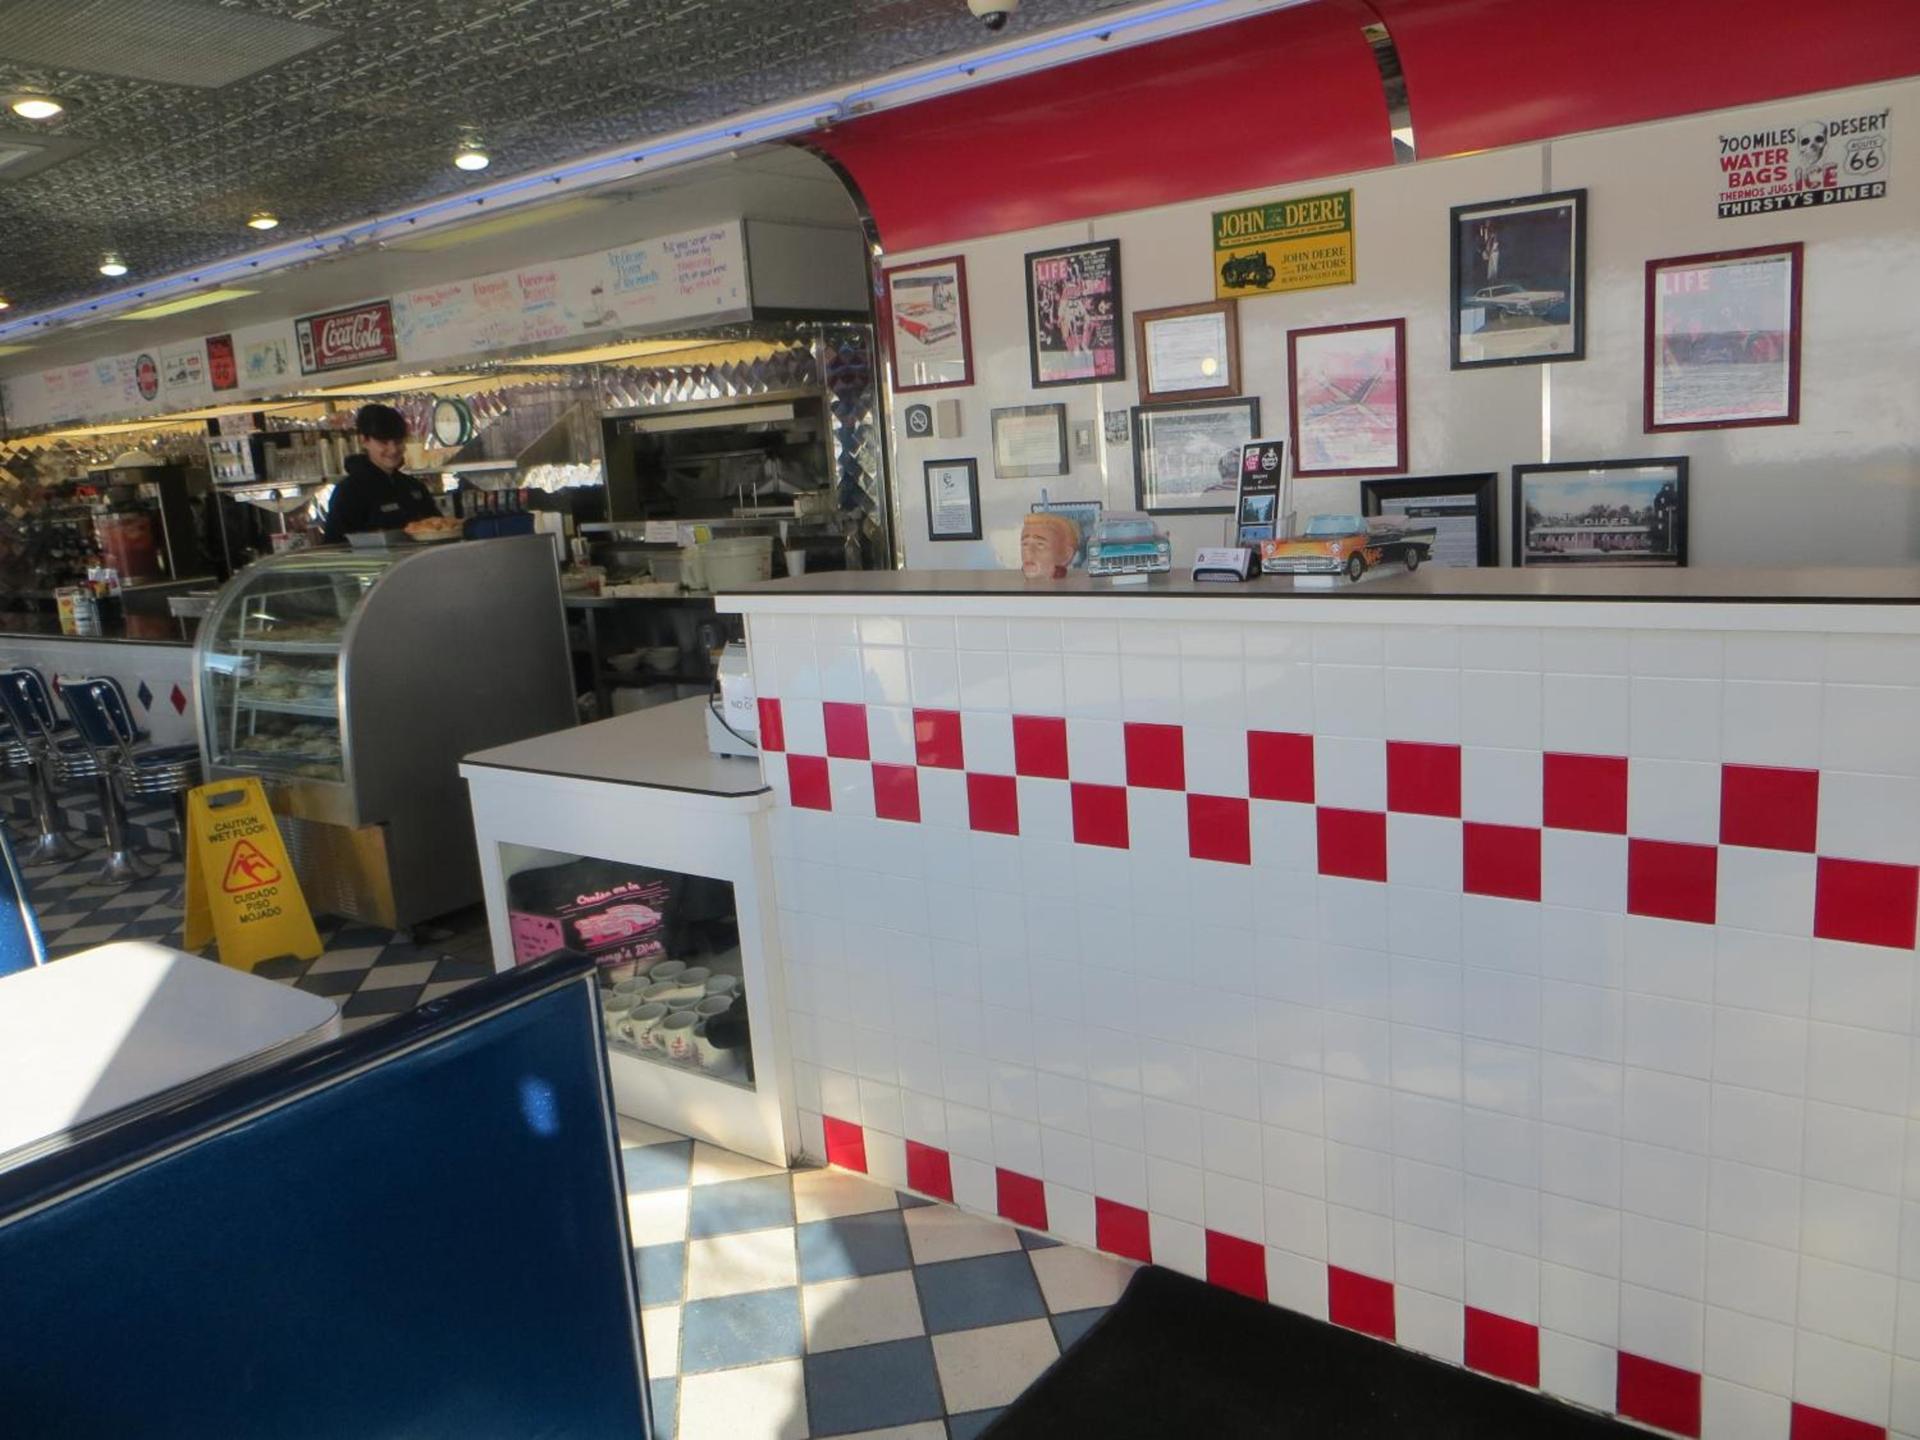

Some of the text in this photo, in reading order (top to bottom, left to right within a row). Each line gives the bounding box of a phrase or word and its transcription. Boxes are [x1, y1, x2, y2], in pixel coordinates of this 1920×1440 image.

[1720, 109, 1890, 154] 700 MILES DESERT
[1720, 148, 1789, 172] WATER
[1850, 152, 1879, 170] 66
[1728, 167, 1788, 188] BAGS
[1795, 163, 1838, 191] ICE
[1720, 184, 1794, 201] THERMOS JUGS
[1720, 184, 1883, 216] THIRSTY'S DINER
[1218, 209, 1264, 238] JOHN
[1285, 197, 1345, 227] DEERE
[1281, 246, 1346, 265] JOHN DEERE
[1296, 258, 1346, 273] TRACTORS
[1037, 261, 1068, 281] LIFE
[1664, 271, 1711, 296] LIFE
[208, 824, 268, 844] WET FLOOR
[214, 817, 258, 832] CAUTION
[234, 886, 278, 904] CUIDADO
[247, 899, 270, 911] PISO
[240, 907, 281, 923] MOJADO
